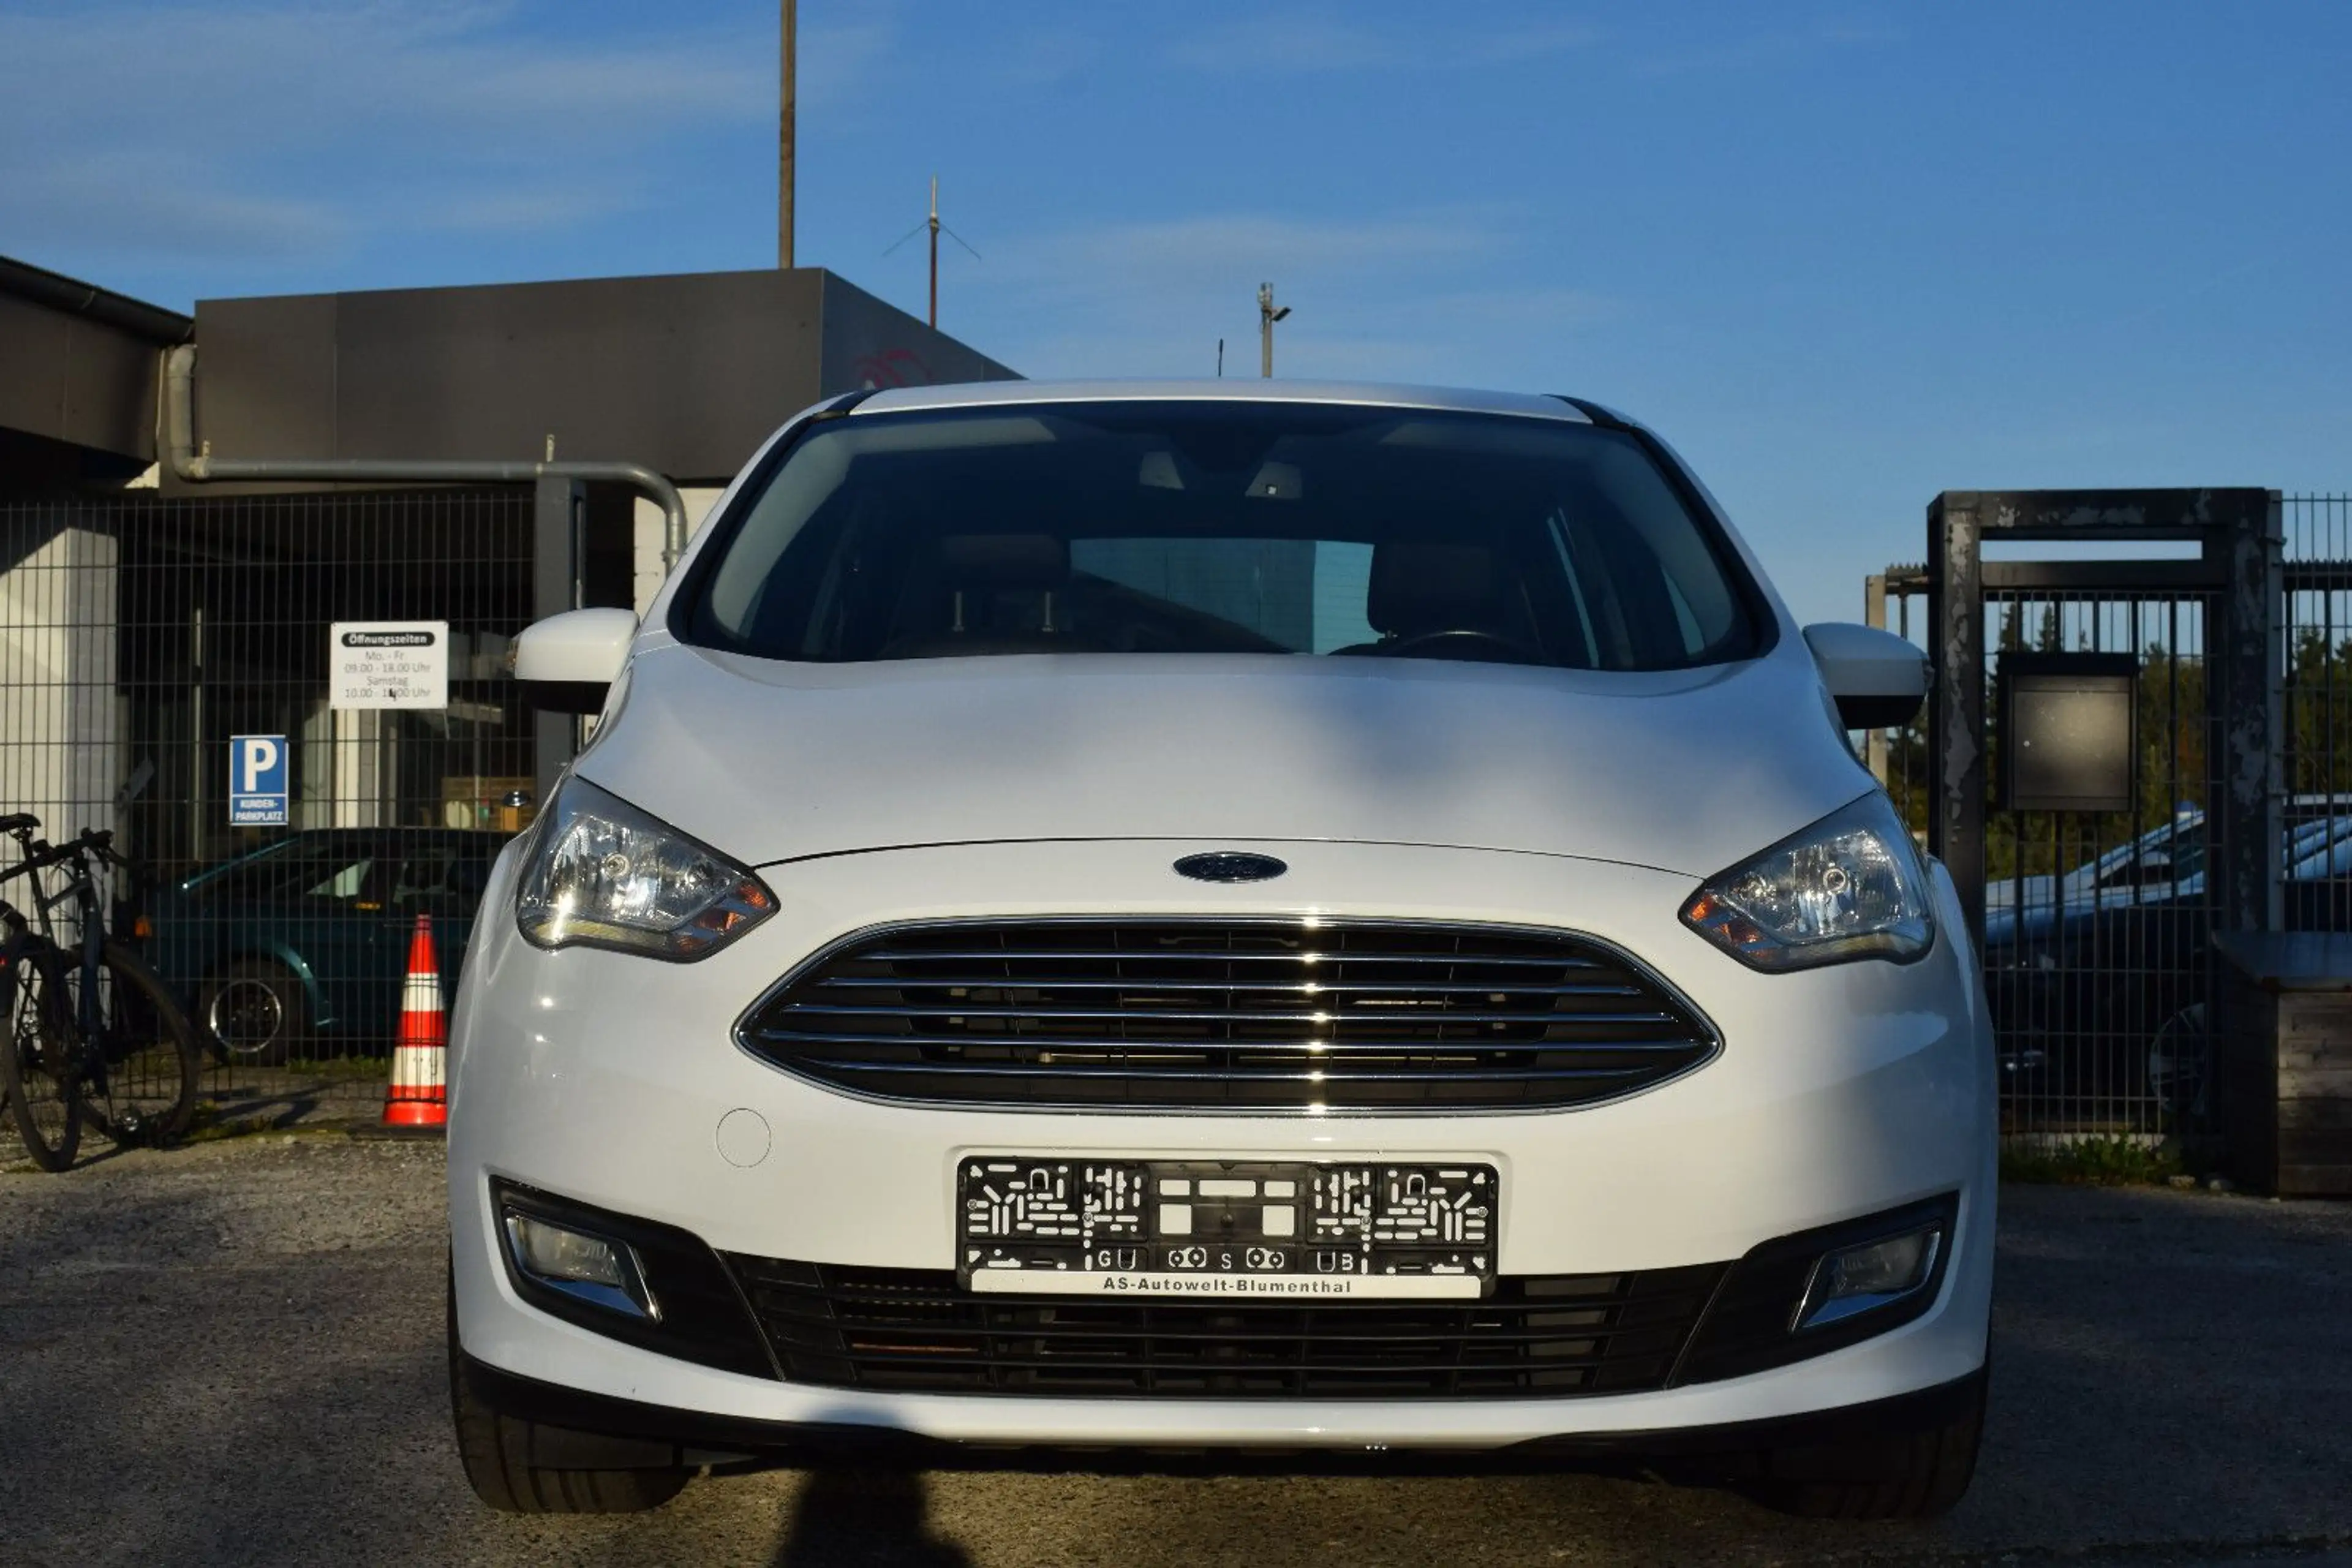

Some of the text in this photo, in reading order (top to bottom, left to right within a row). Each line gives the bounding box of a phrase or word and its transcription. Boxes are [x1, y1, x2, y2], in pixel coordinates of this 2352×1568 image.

[349, 633, 427, 646] Öffnungszeiten
[412, 663, 431, 673] Uhr
[366, 677, 409, 687] Samstag
[412, 687, 431, 698] Uhr
[244, 739, 277, 792] P
[235, 811, 284, 821] PARKPLATZ
[1104, 1277, 1351, 1292] AS-Autowelt-Blumenthal
